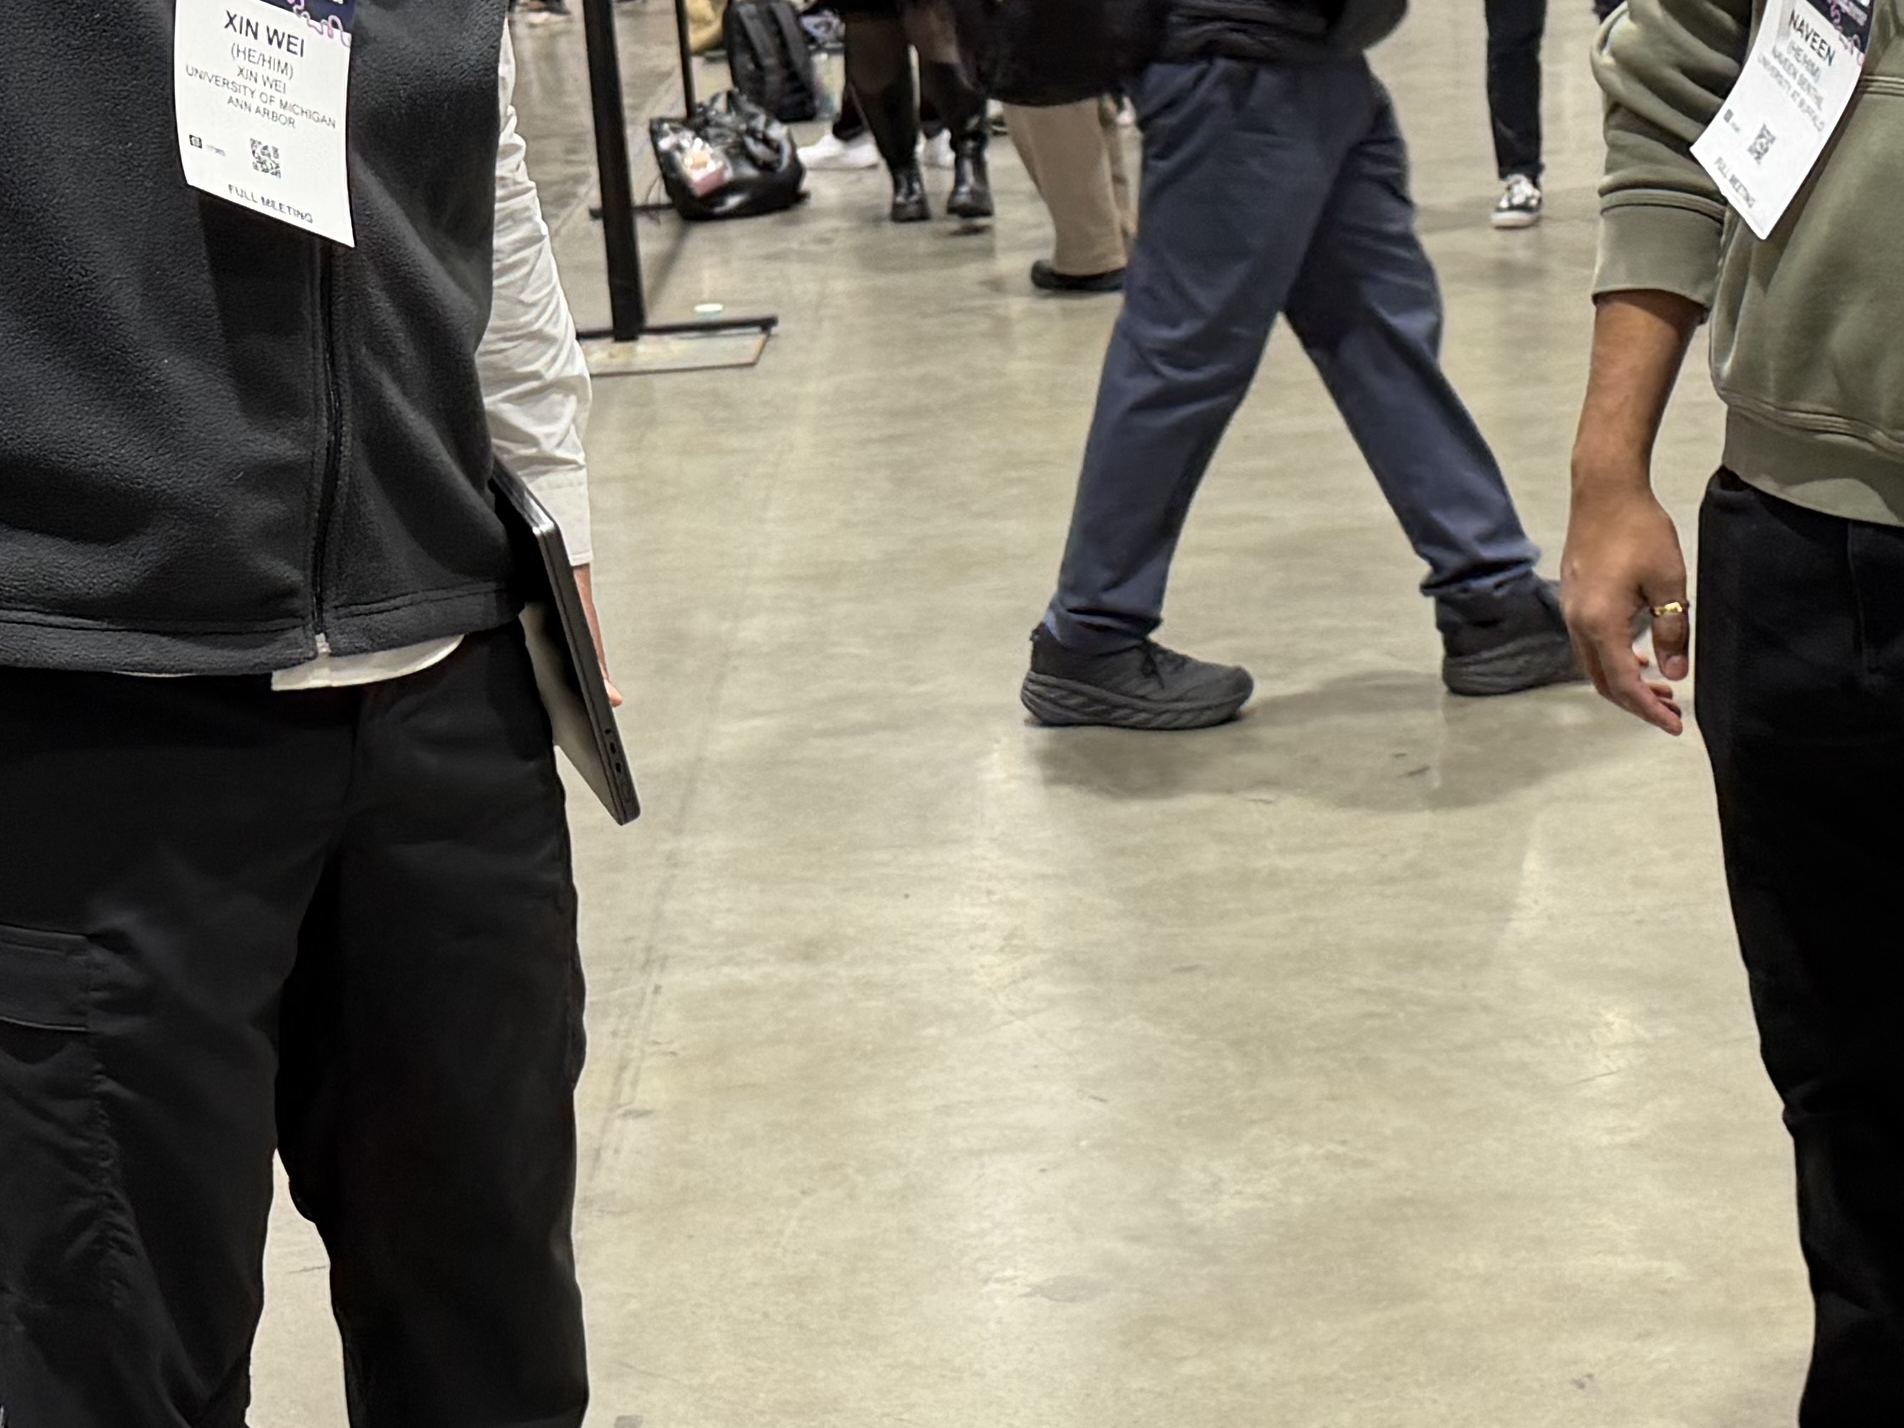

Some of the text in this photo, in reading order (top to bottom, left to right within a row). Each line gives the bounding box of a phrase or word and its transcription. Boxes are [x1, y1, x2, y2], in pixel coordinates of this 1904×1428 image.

[224, 10, 305, 58] XIN WEI
[1783, 8, 1840, 69] NAVEEN
[230, 42, 294, 80] (HE/HIM)
[236, 65, 287, 94] XIN WEI
[185, 64, 336, 129] UNIVERSITY OF MICHIGAN
[227, 95, 296, 129] ANN ARBOR
[227, 183, 313, 224] FULL MEETING
